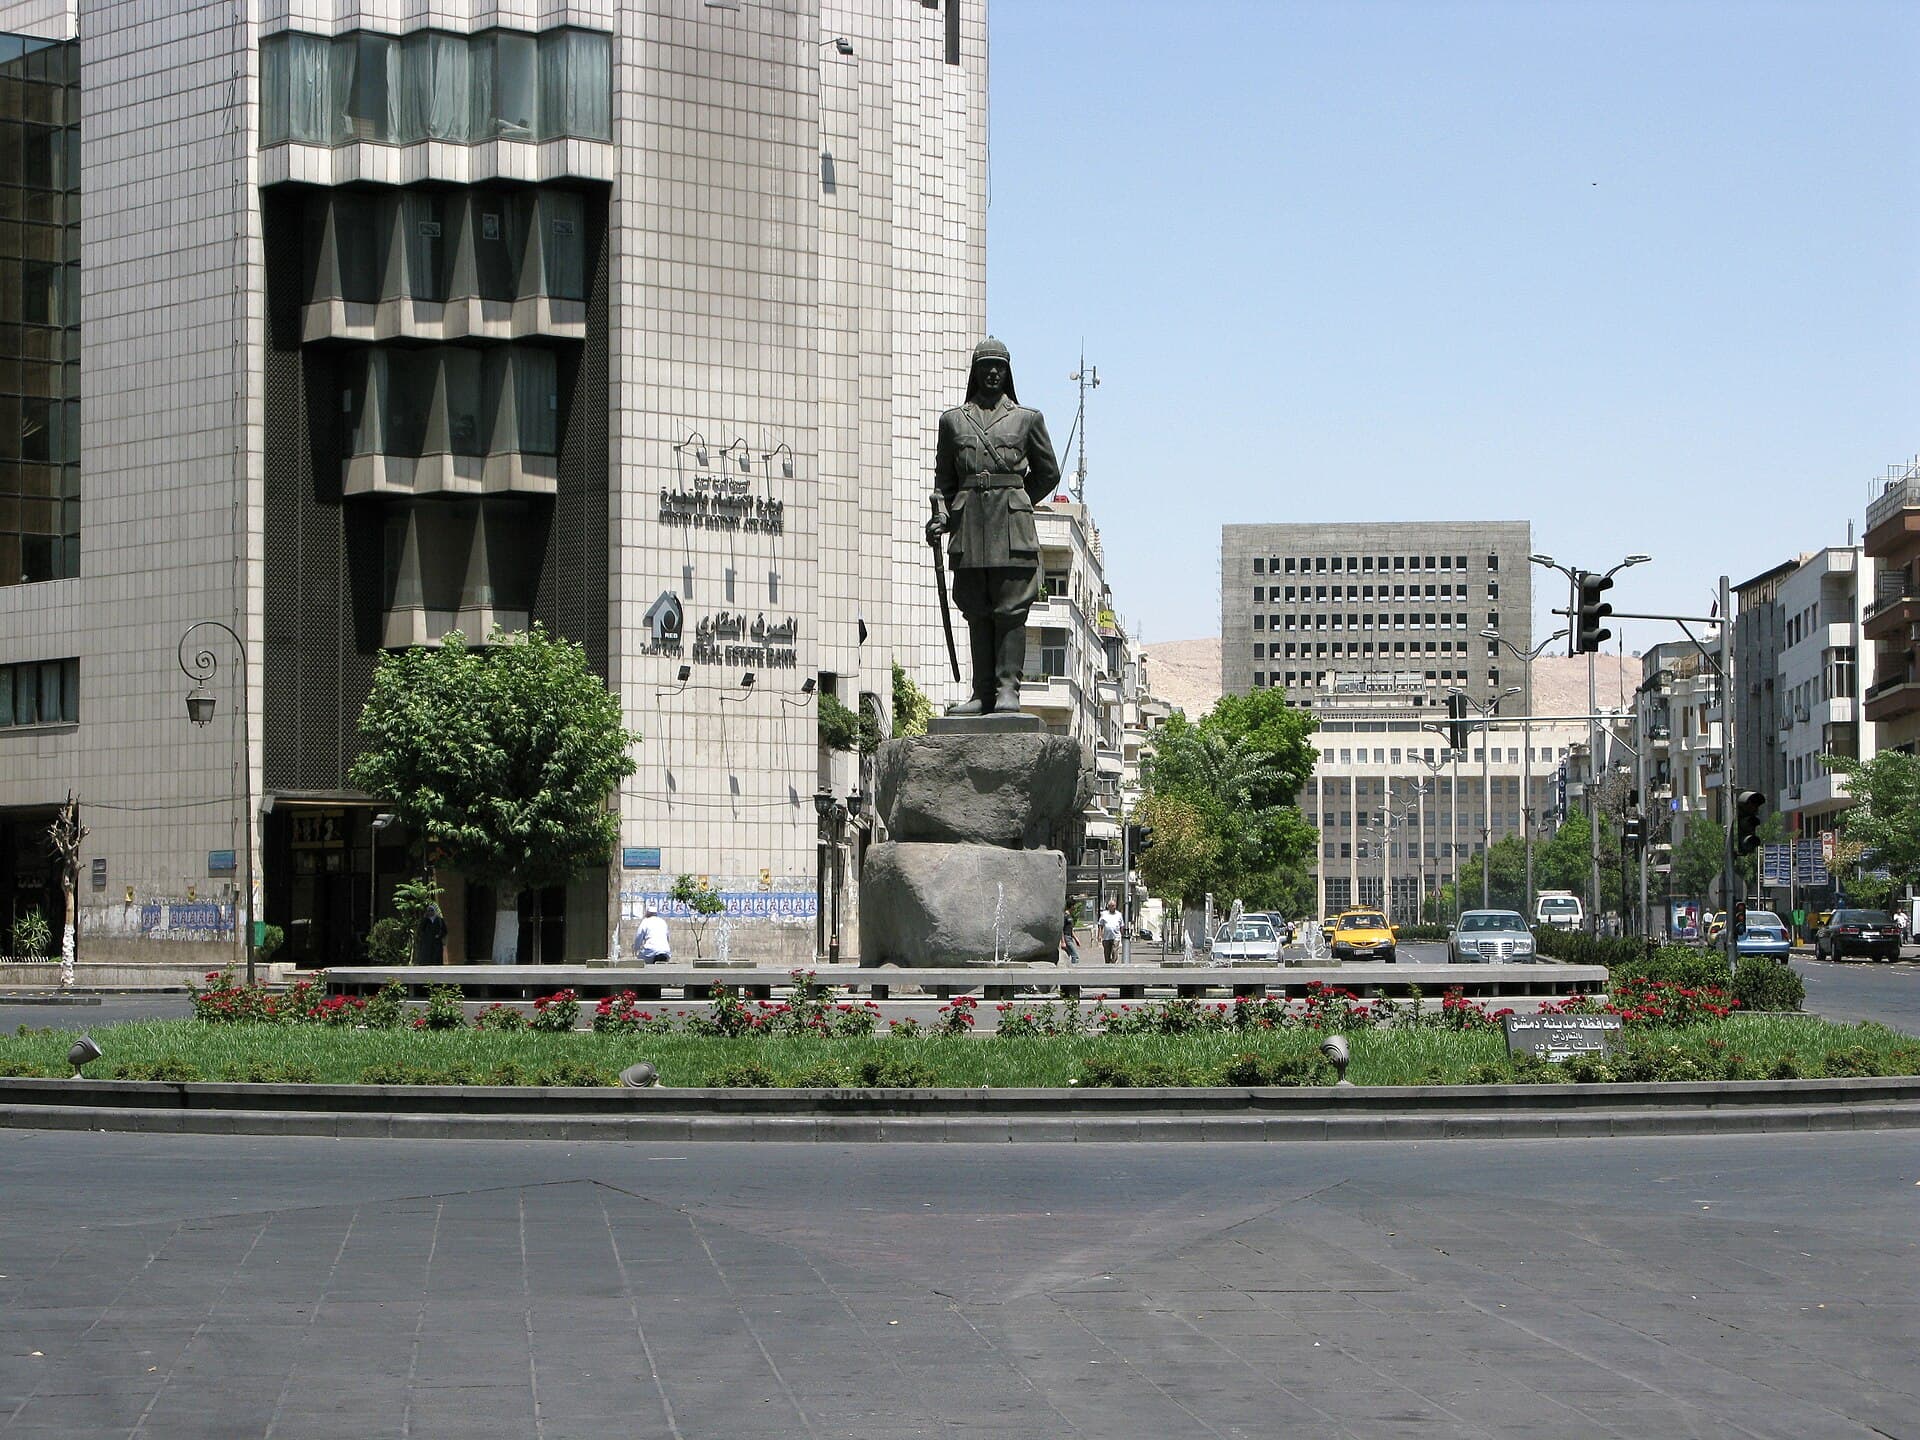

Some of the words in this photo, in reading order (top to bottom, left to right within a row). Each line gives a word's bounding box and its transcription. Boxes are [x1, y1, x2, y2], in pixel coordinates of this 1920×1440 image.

[695, 611, 748, 640] العقاري
[750, 611, 798, 642] المصرف
[692, 643, 723, 665] REAL
[725, 645, 766, 667] ESTATE
[766, 647, 797, 669] BANK
[1510, 1016, 1540, 1032] دمشق
[1541, 1017, 1577, 1032] مدينة
[1576, 1017, 1621, 1030] محافظة
[1551, 1033, 1561, 1042] مع
[1560, 1031, 1583, 1042] بالتعاون
